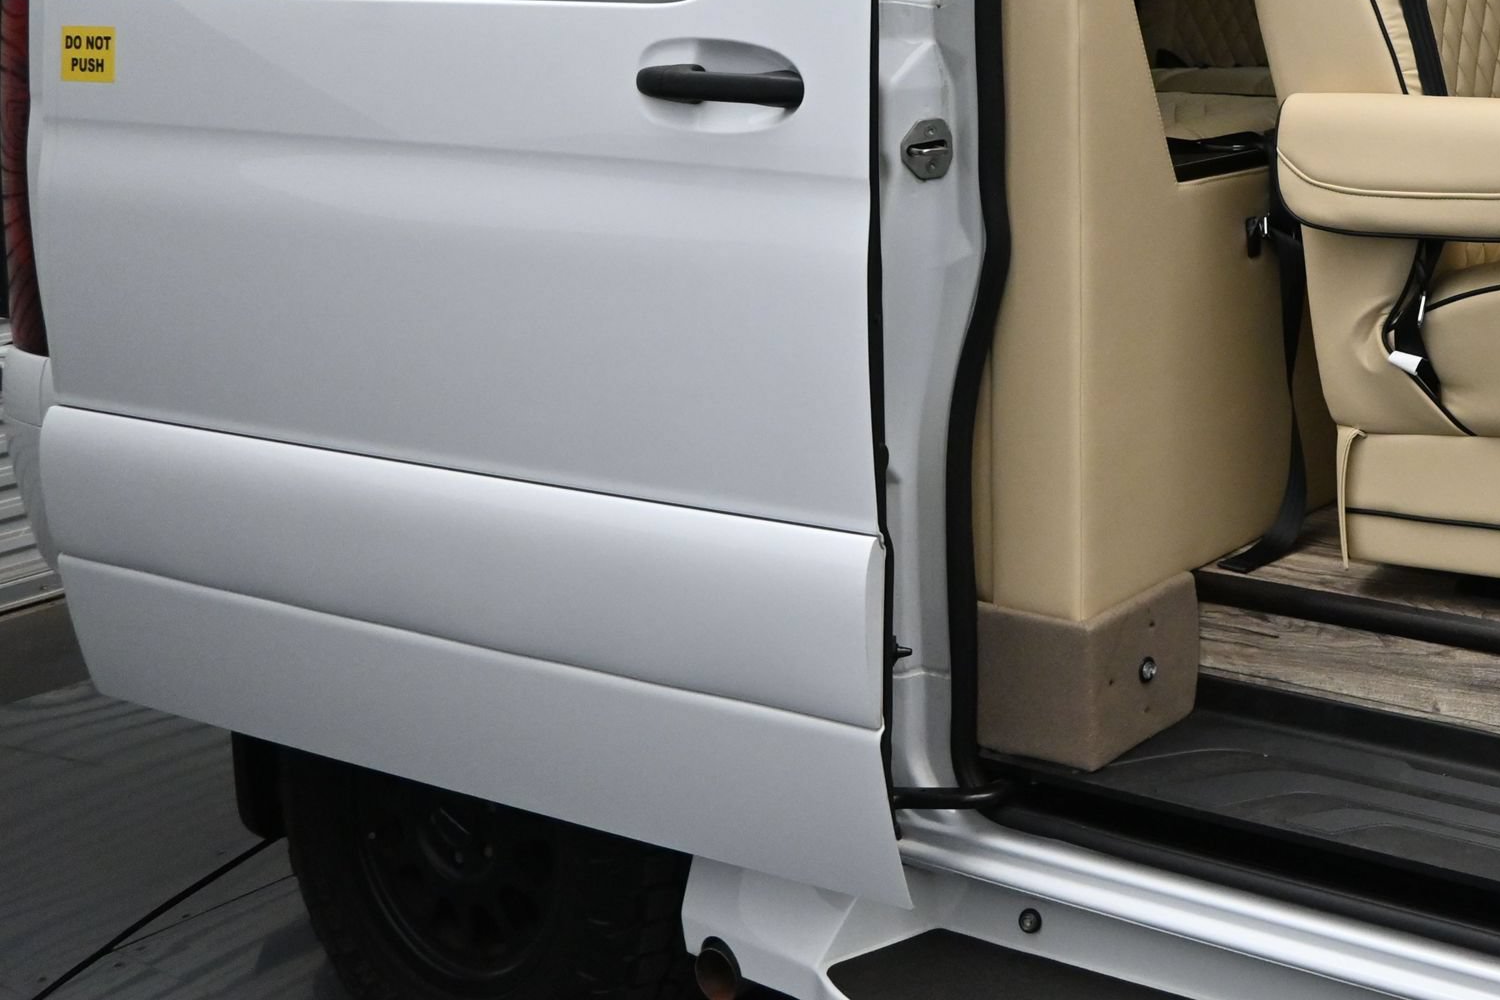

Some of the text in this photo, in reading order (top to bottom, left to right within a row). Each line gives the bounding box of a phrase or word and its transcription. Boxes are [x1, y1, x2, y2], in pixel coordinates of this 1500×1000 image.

[65, 35, 111, 50] DO NOT
[71, 58, 104, 72] PUSH
